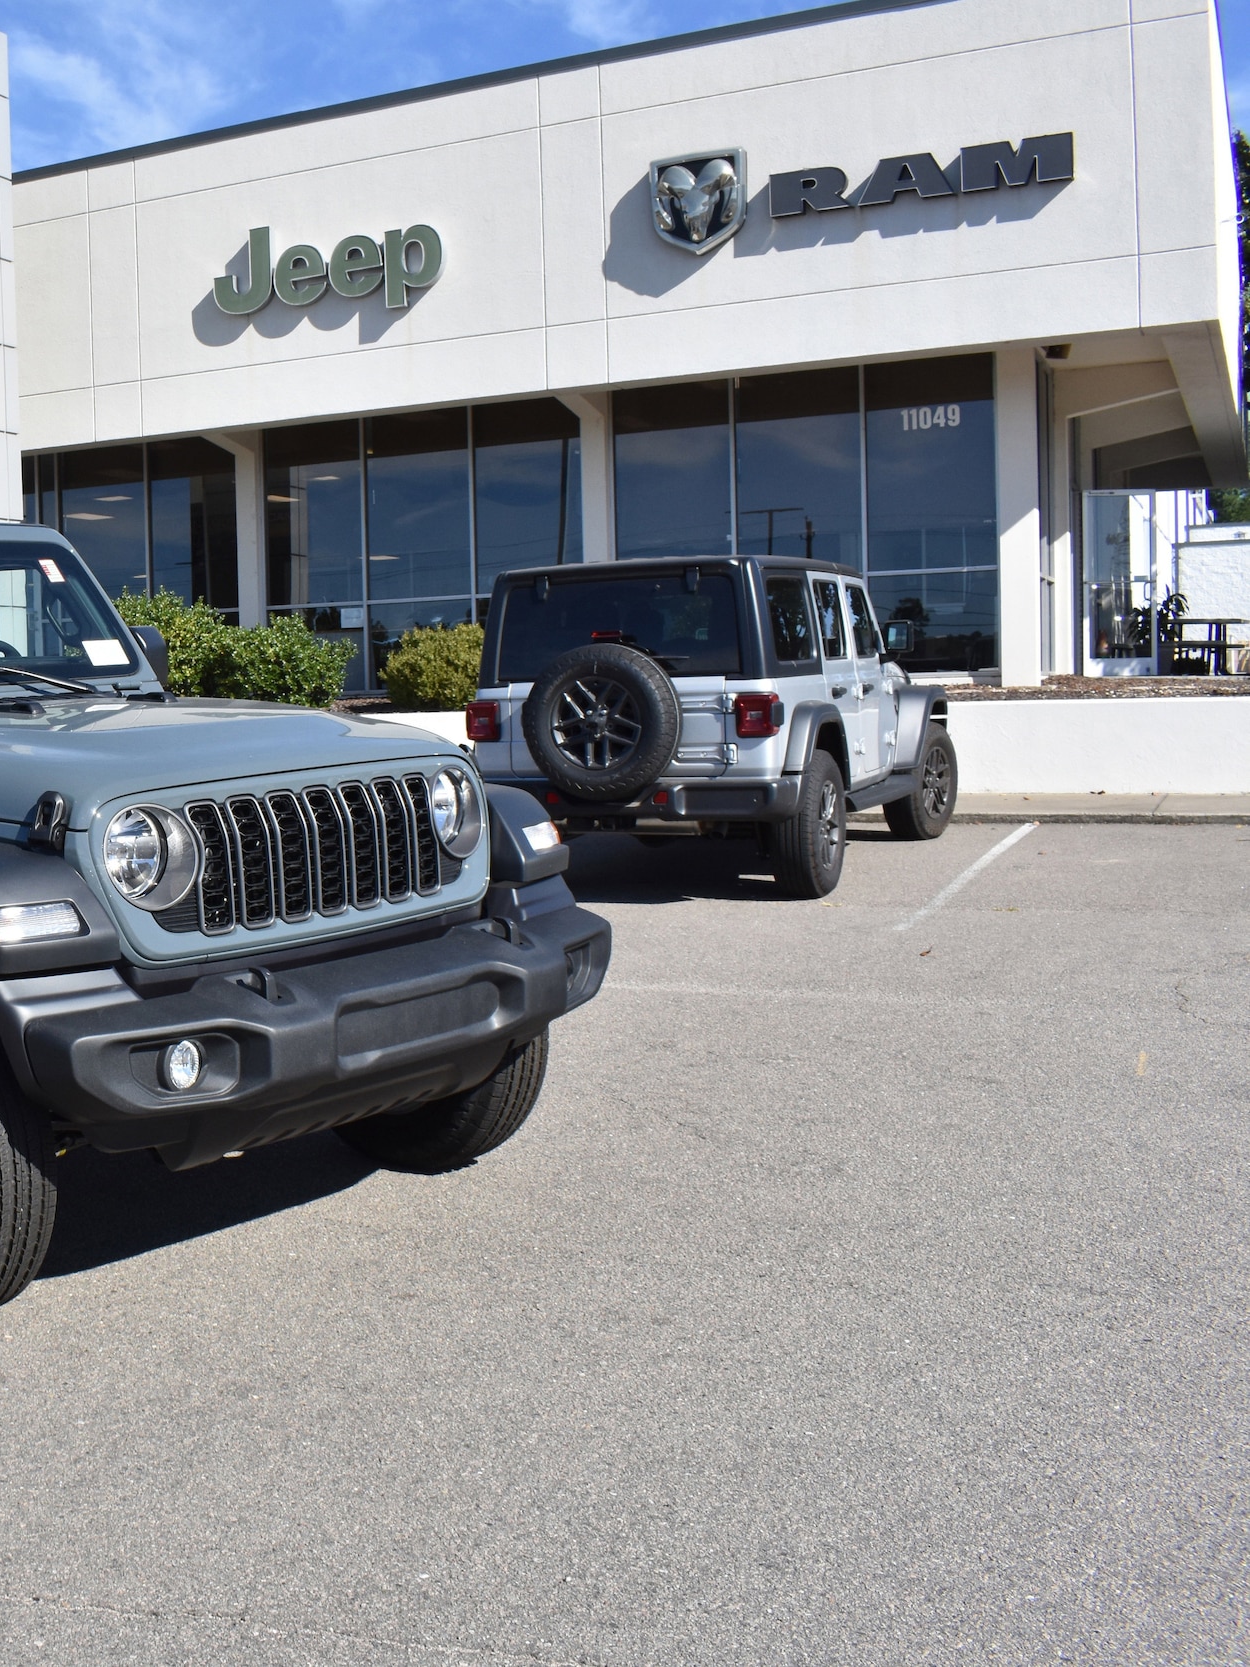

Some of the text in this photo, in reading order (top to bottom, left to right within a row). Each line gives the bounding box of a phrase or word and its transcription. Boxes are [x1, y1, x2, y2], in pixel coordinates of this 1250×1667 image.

[769, 131, 1075, 218] RAM
[213, 223, 446, 314] Jeep
[901, 404, 960, 431] 11049
